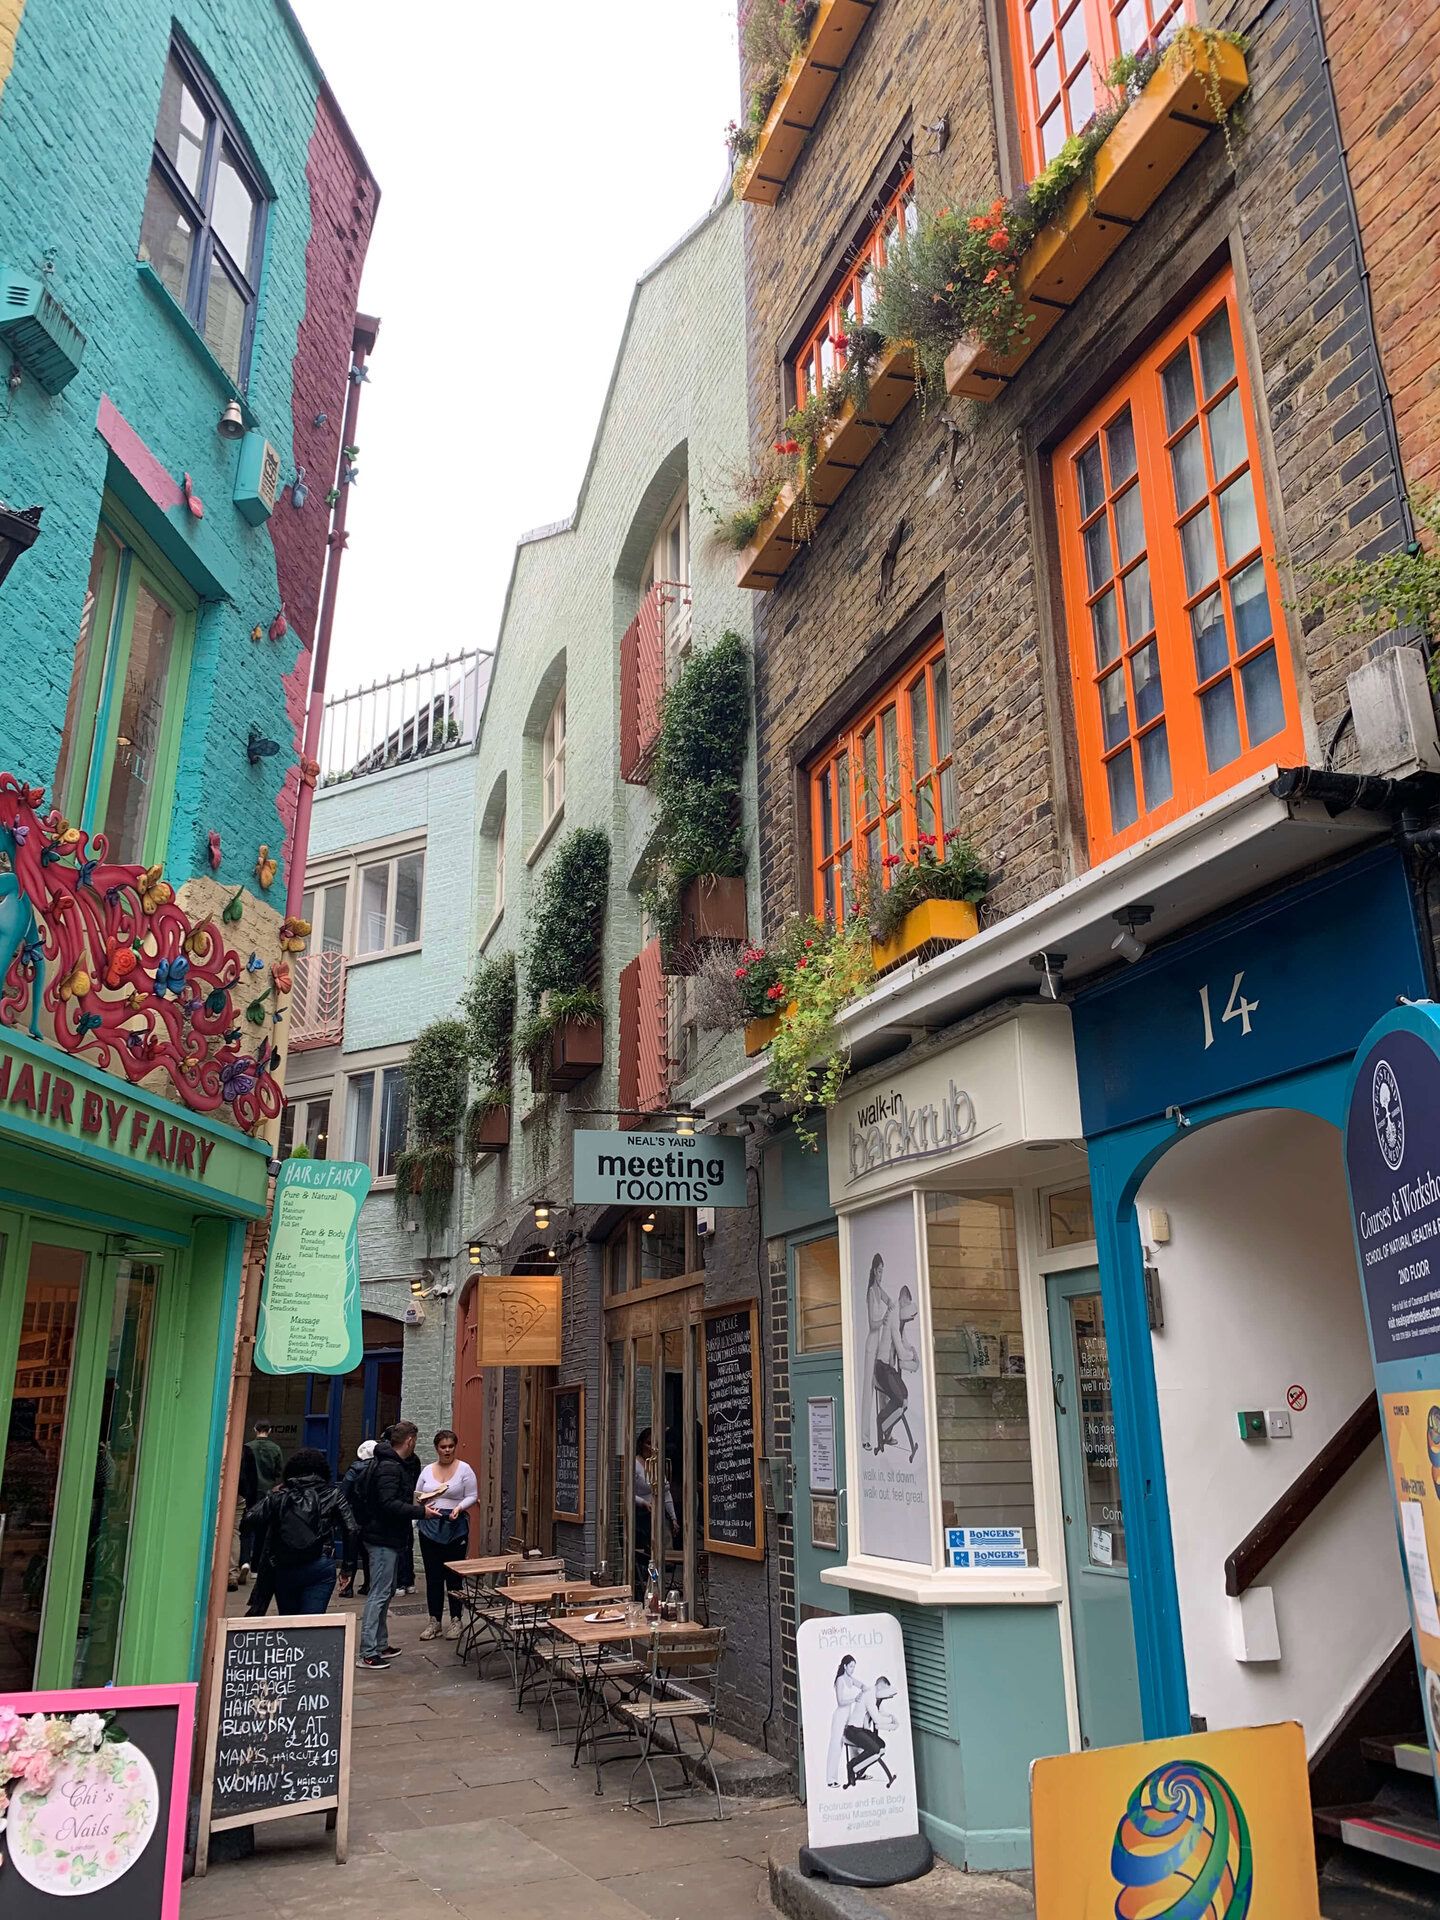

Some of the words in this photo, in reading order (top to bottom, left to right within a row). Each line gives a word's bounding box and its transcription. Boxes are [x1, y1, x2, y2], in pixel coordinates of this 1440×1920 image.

[1199, 971, 1259, 1050] 14
[858, 1090, 902, 1128] walk-in
[81, 1089, 128, 1141] BY
[130, 1110, 216, 1175] FAIRY
[849, 1080, 976, 1174] backrub
[627, 1136, 665, 1147] NEAL'S
[667, 1137, 696, 1148] YARD
[285, 1162, 312, 1185] HAIR
[325, 1166, 362, 1187] FAIRY
[598, 1152, 724, 1186] meeting
[284, 1191, 300, 1199] Pure
[302, 1191, 308, 1199] &
[311, 1192, 338, 1200] Natural
[616, 1179, 708, 1201] rooms
[1360, 1206, 1392, 1240] Courses
[1391, 1192, 1402, 1223] &
[1398, 1170, 1440, 1217] Worksho
[300, 1228, 317, 1236] Face
[319, 1229, 325, 1237] &
[327, 1229, 346, 1239] Body
[1365, 1247, 1384, 1266] SCHOOL
[1382, 1243, 1390, 1258] OF
[1389, 1233, 1412, 1255] NATURAL
[1411, 1221, 1432, 1245] HEALTH
[1432, 1219, 1438, 1236] &
[275, 1253, 291, 1261] Hair
[1398, 1267, 1410, 1285] 2ND
[1409, 1259, 1431, 1281] FLOOR
[290, 1315, 320, 1326] Massage
[1081, 1352, 1108, 1364] Backru
[1088, 1423, 1099, 1435] No
[1101, 1424, 1115, 1434] nee
[1082, 1442, 1093, 1453] No
[1094, 1442, 1114, 1453] need
[1102, 1506, 1123, 1521] Com
[233, 1631, 289, 1649] OFFER
[818, 1628, 883, 1649] backrub
[821, 1626, 847, 1636] walk-in
[228, 1649, 262, 1666] FULL
[264, 1647, 305, 1664] HEAD
[307, 1661, 331, 1679] OR
[225, 1680, 297, 1699] BALAYAGE
[297, 1694, 330, 1712] AND
[305, 1715, 327, 1734] AT
[284, 1730, 329, 1748] £110
[307, 1749, 338, 1767] £19
[61, 1780, 114, 1811] Chi's
[283, 1785, 322, 1801] £28
[871, 1797, 885, 1806] Full
[886, 1795, 906, 1804] Body
[55, 1813, 112, 1841] Nails
